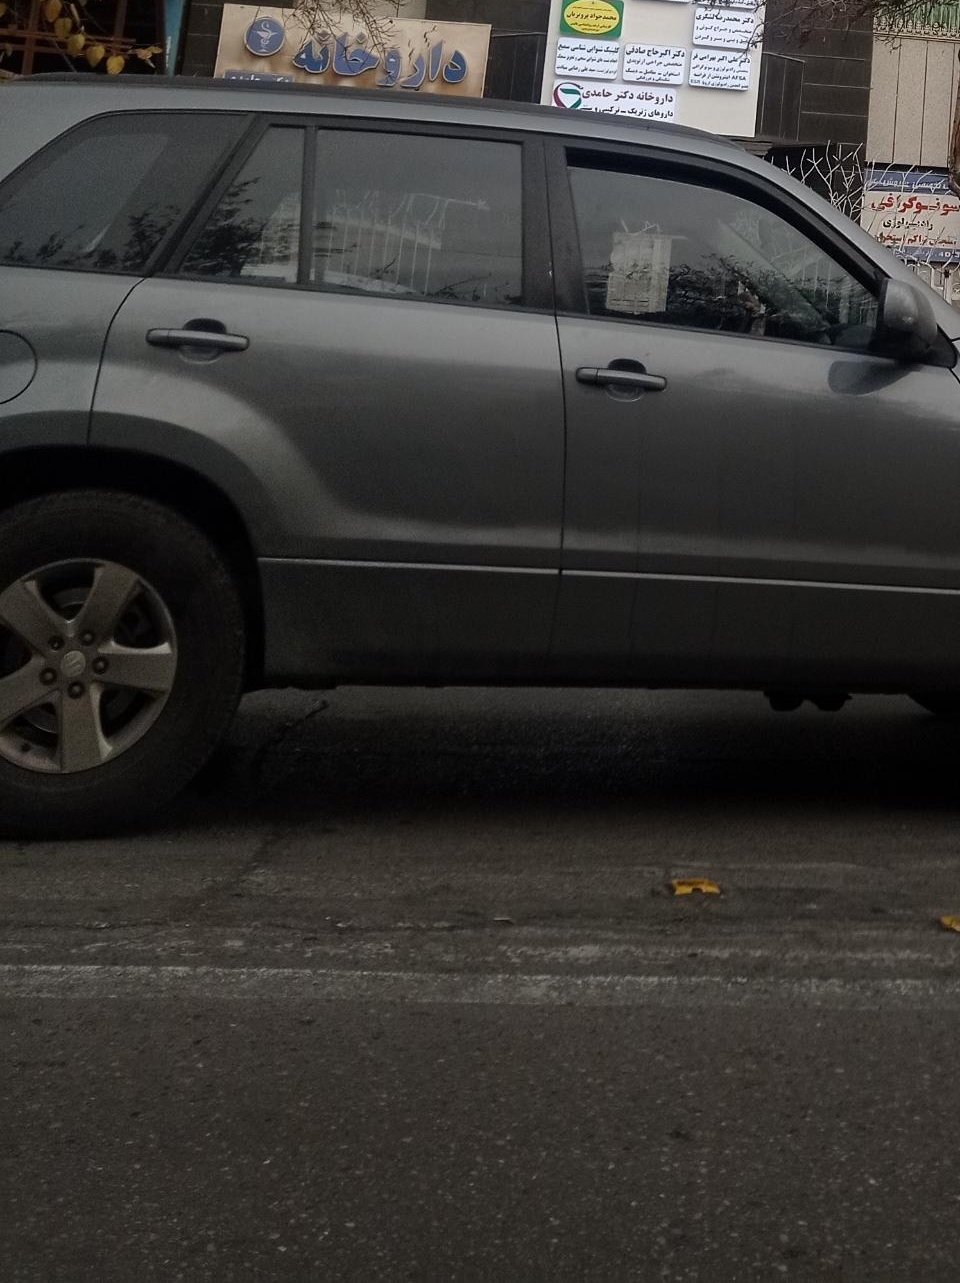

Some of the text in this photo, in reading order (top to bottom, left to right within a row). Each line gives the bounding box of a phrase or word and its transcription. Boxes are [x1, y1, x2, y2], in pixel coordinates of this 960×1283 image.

[626, 46, 646, 55] صادقی
[659, 49, 671, 58] اکبر
[672, 50, 685, 59] دکتر
[292, 29, 468, 88] داروخانه
[582, 88, 673, 105] داروخانه دکتر حامدی
[628, 107, 647, 117] ژنریک
[648, 109, 673, 118] داروهای
